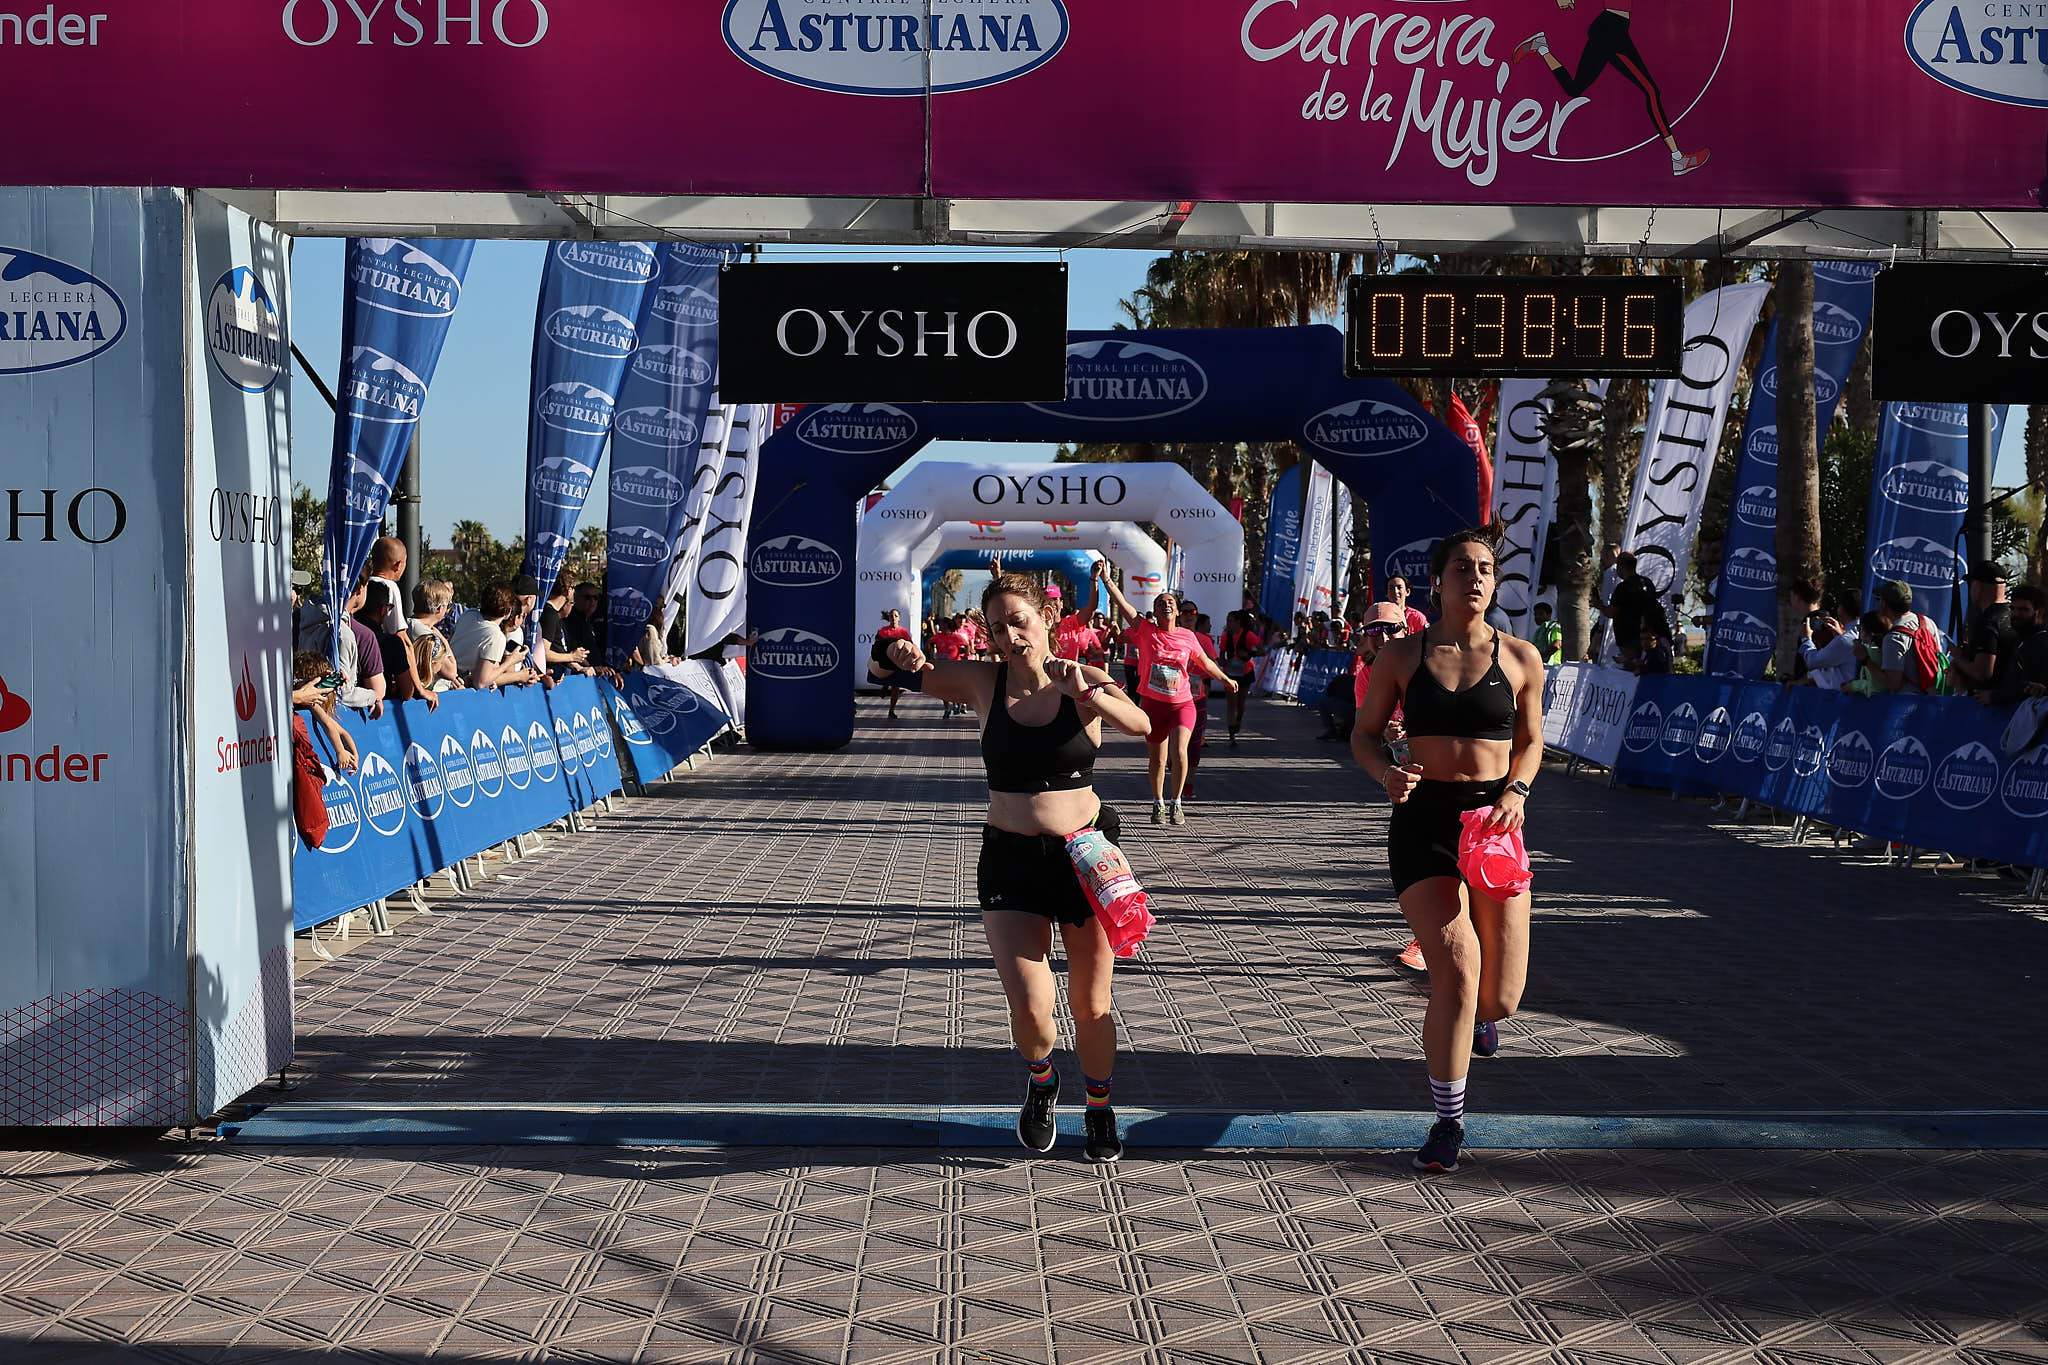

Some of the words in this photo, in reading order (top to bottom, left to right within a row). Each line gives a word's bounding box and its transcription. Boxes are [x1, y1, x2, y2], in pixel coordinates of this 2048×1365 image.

[282, 0, 549, 47] OYSHO
[748, 0, 1042, 52] ASTURIANA
[1241, 0, 1496, 67] Carrera
[1302, 69, 1348, 121] de
[1359, 68, 1393, 122] la
[1385, 62, 1591, 186] Mujer
[564, 241, 651, 277] ASTURIANA
[404, 266, 452, 289] LECHERA
[10, 291, 96, 303] LECHERA
[213, 302, 279, 367] ASTURIANA
[776, 308, 1017, 359] OYSHO
[1372, 293, 1656, 358] 00:38:46
[632, 353, 705, 380] ASTURIANA
[1124, 363, 1187, 373] LECHERA
[621, 415, 692, 441] ASTURIANA
[803, 418, 908, 440] ASTURIANA
[1314, 422, 1421, 443] ASTURIANA
[611, 474, 678, 501] ASTURIANA
[972, 474, 1126, 505] OYSHO
[1886, 474, 1968, 505] ASTURIAN
[209, 487, 282, 546] OYSHO
[881, 509, 927, 520] OYSHO
[1170, 508, 1216, 519] OYSHO
[754, 554, 836, 574] ASTURIANA
[860, 571, 902, 582] OYSHO
[1193, 572, 1236, 583] OYSHO
[752, 646, 832, 666] ASTURIANA
[217, 731, 278, 773] Santander
[1937, 765, 1992, 794] ASTURIANA
[364, 786, 404, 818] ASTURIANA
